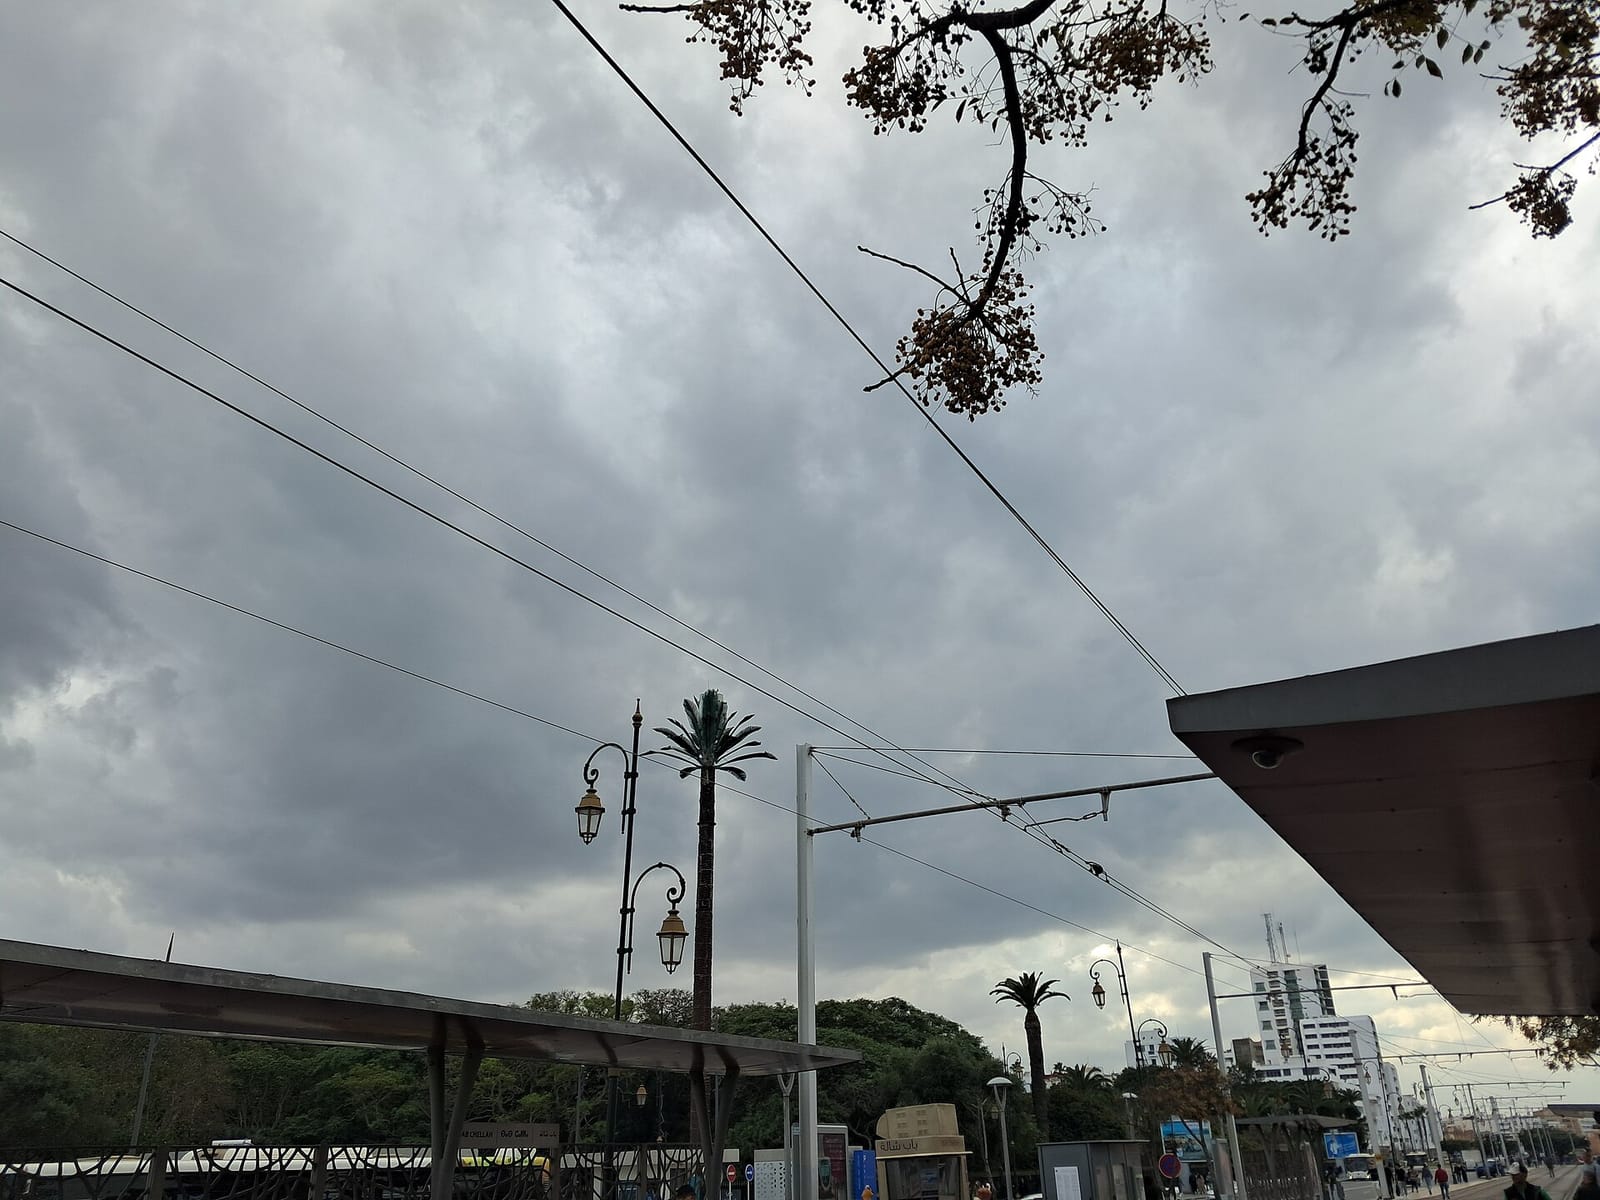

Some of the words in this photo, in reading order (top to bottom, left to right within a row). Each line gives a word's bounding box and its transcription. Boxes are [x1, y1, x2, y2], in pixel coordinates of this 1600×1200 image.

[470, 1130, 493, 1138] CHELLAH
[880, 1140, 901, 1152] شالة
[902, 1139, 918, 1151] باب
